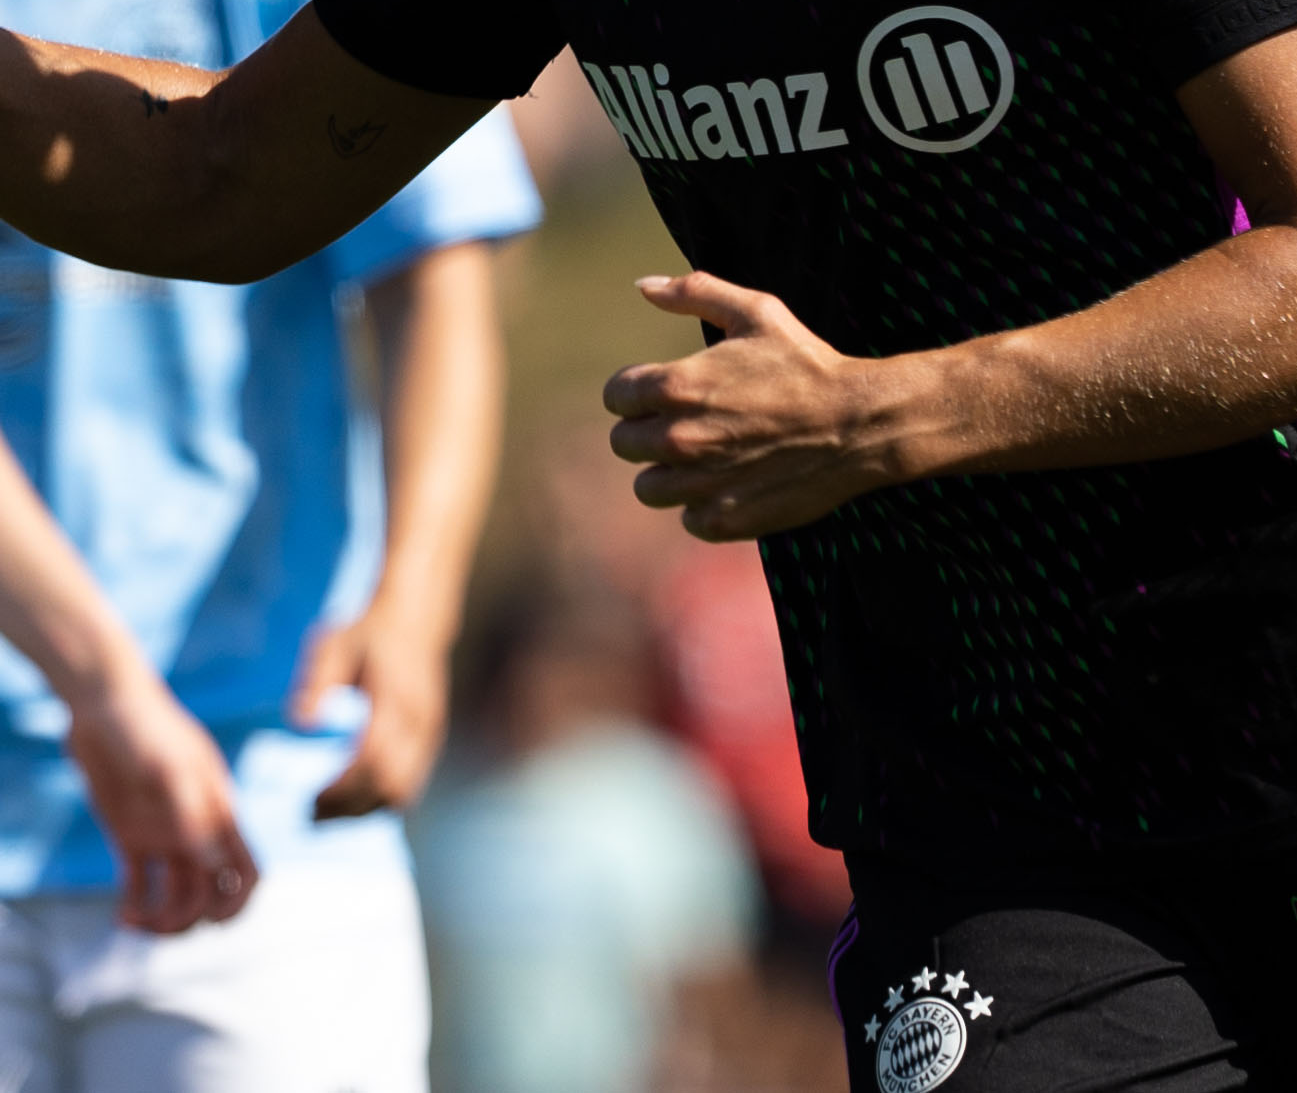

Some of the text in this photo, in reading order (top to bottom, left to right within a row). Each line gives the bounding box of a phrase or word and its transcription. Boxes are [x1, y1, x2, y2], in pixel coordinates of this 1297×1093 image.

[581, 61, 850, 162] Allianz
[883, 1006, 957, 1052] FC BAYERN
